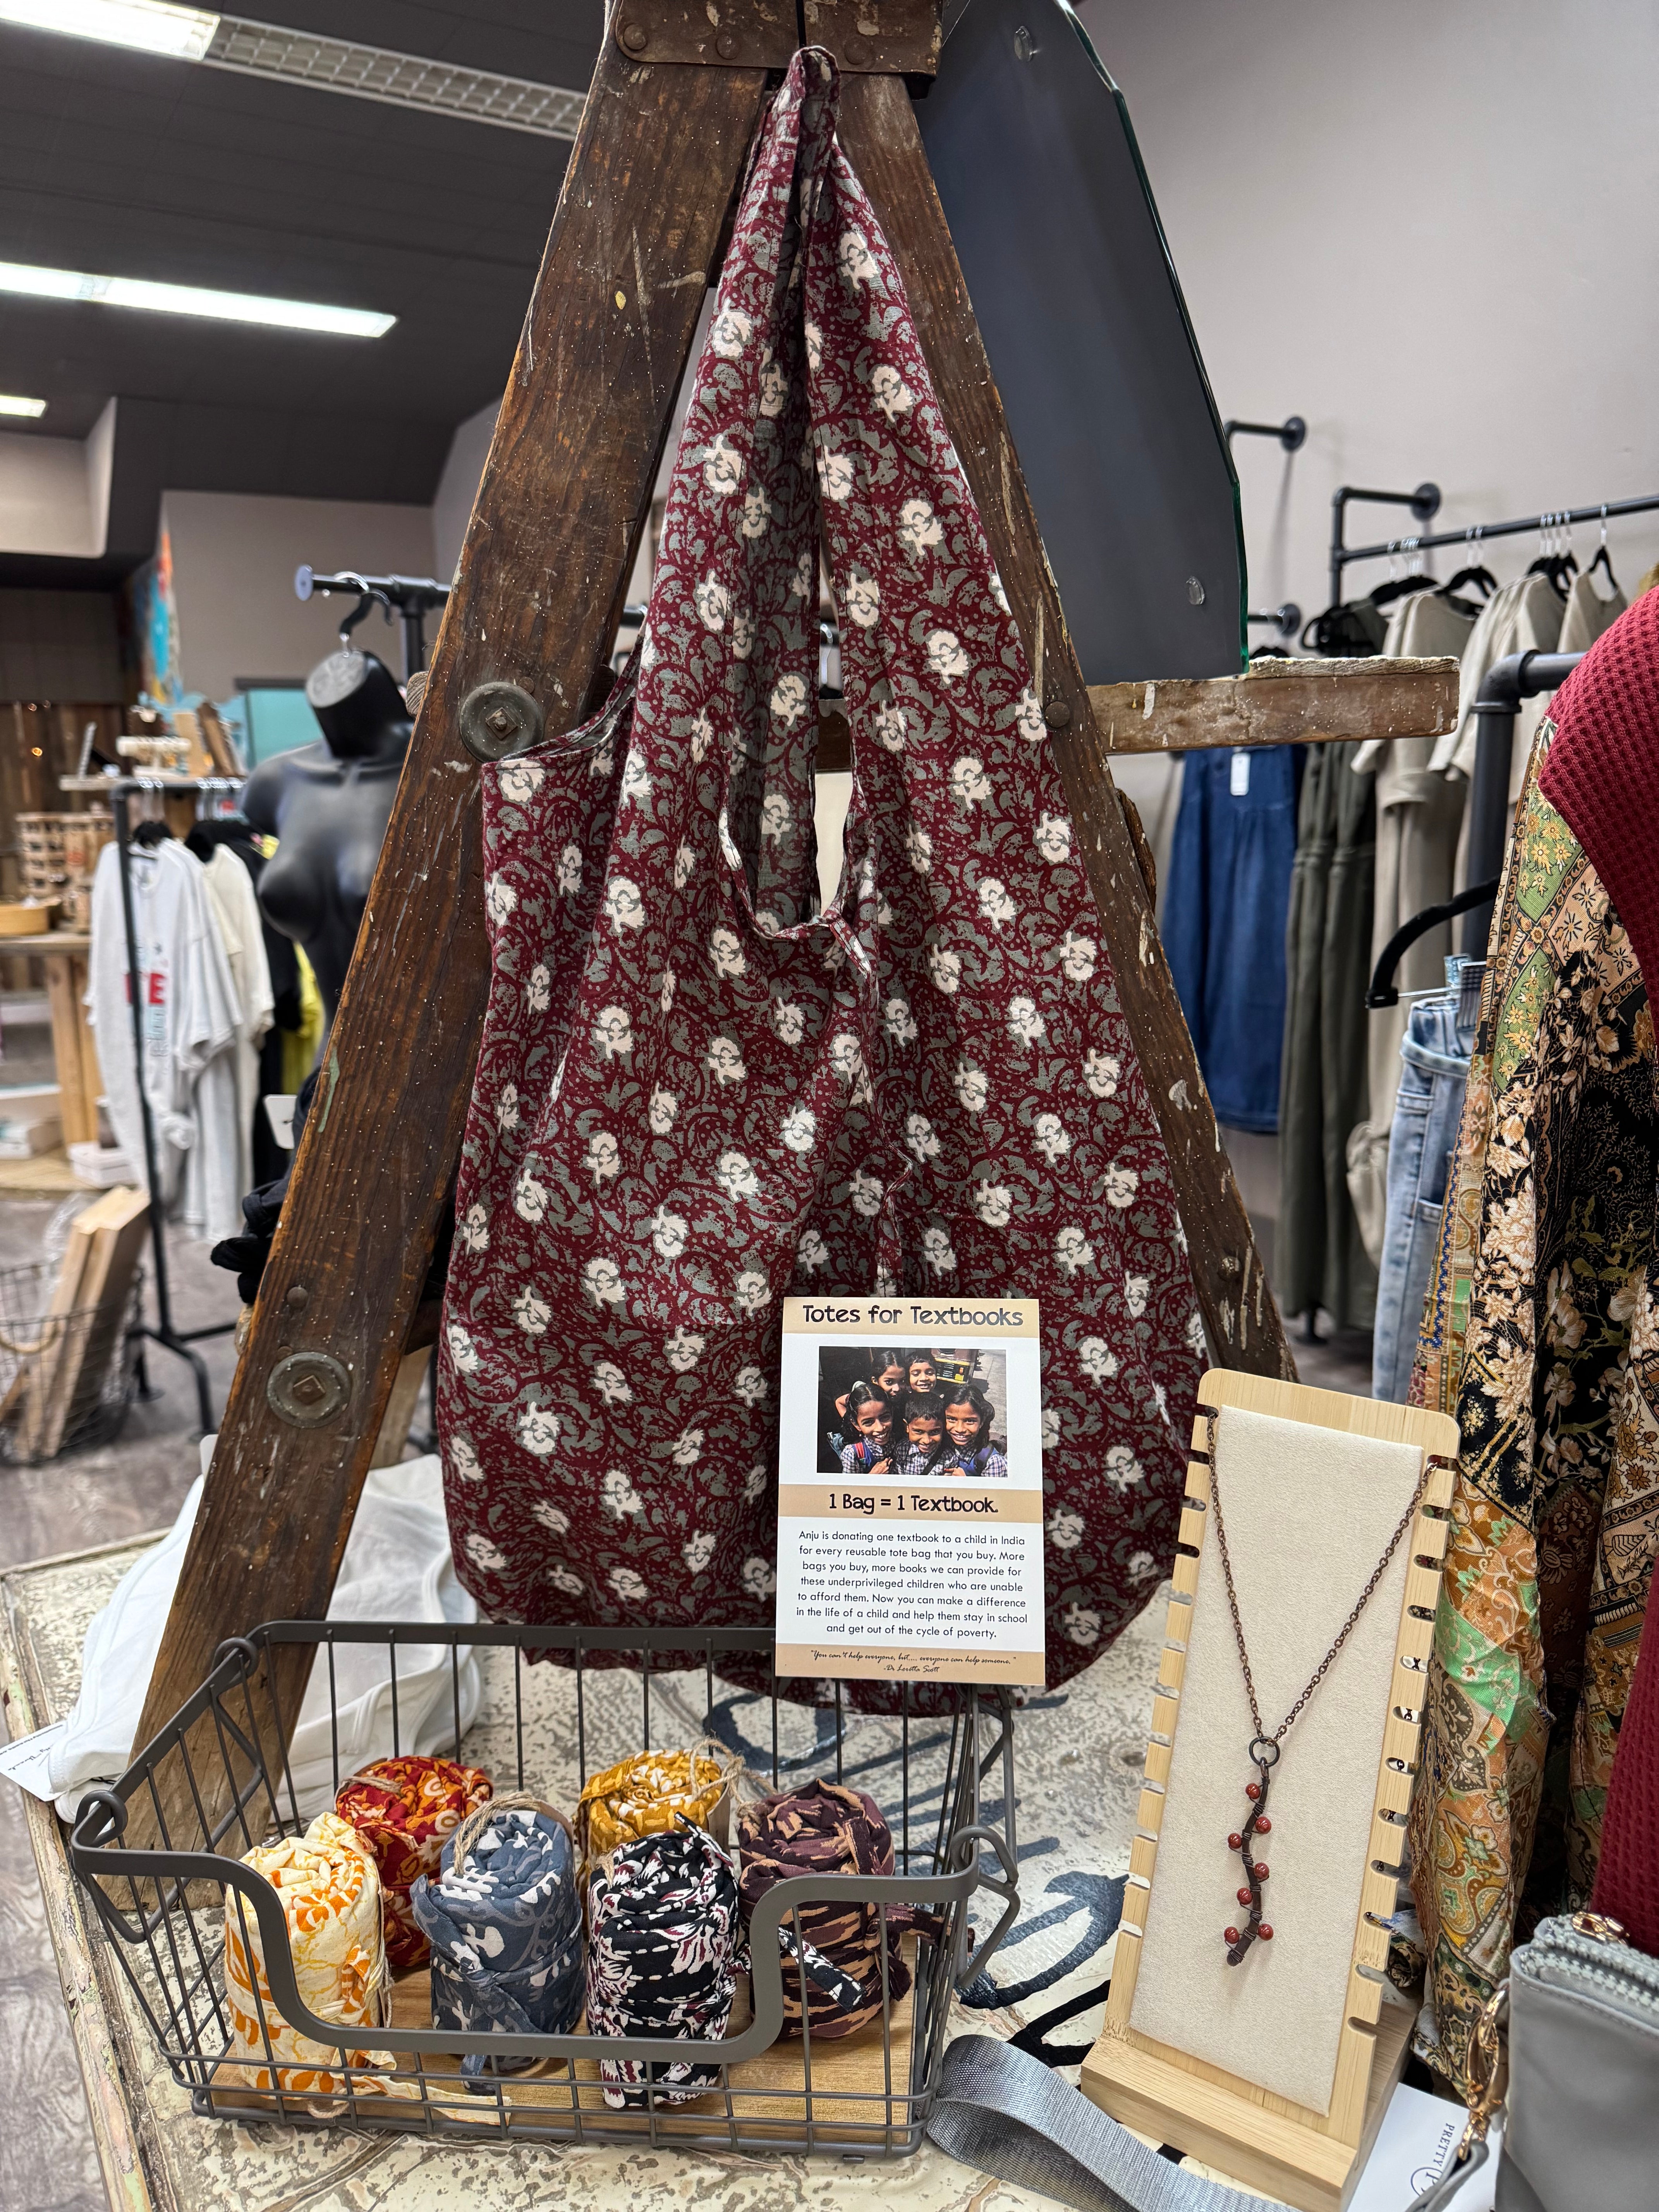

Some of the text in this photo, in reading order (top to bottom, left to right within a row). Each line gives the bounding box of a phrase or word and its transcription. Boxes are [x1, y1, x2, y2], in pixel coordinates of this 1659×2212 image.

[802, 1305, 1024, 1326] Totes for Textbooks
[829, 1493, 837, 1509] 1
[843, 1493, 875, 1515] Bag
[897, 1495, 905, 1511] 1
[910, 1495, 998, 1513] Textbook.
[799, 1530, 819, 1542] Anju
[822, 1531, 829, 1540] is
[832, 1530, 873, 1543] donating
[897, 1533, 939, 1542] textbook
[964, 1534, 986, 1544] child
[990, 1535, 998, 1544] in
[1001, 1535, 1025, 1545] India
[799, 1545, 1025, 1562] for every reusable tote bag that you buy. More
[802, 1560, 826, 1572] bags
[829, 1564, 846, 1573] you
[849, 1561, 869, 1574] buy,
[899, 1563, 927, 1573] books
[967, 1566, 1004, 1577] provide
[1008, 1566, 1022, 1576] for
[800, 1576, 825, 1585] these
[828, 1577, 903, 1590] underprivileged
[907, 1579, 944, 1589] children
[948, 1580, 967, 1590] who
[990, 1582, 1023, 1592] unable
[798, 1592, 807, 1601] to
[810, 1591, 840, 1601] afford
[844, 1592, 869, 1602] them.
[872, 1593, 894, 1603] Now
[897, 1597, 914, 1606] you
[937, 1595, 963, 1605] make
[976, 1596, 1026, 1607] difference
[796, 1607, 804, 1616] in
[807, 1606, 822, 1616] the
[825, 1607, 840, 1617] life
[843, 1607, 854, 1617] of
[866, 1608, 889, 1618] child
[892, 1609, 910, 1619] and
[914, 1610, 934, 1622] help
[937, 1611, 960, 1621] them
[963, 1613, 983, 1624] stay
[987, 1613, 995, 1622] in
[998, 1613, 1027, 1623] school
[826, 1623, 996, 1640] and get out of the cycle of poverty.
[848, 1651, 864, 1662] help
[864, 1655, 896, 1664] everyone,
[919, 1657, 950, 1665] everyone
[965, 1655, 981, 1666] help
[896, 1664, 921, 1672] Loretta
[922, 1665, 940, 1673] Scott
[1433, 2123, 1455, 2166] PRETTY
